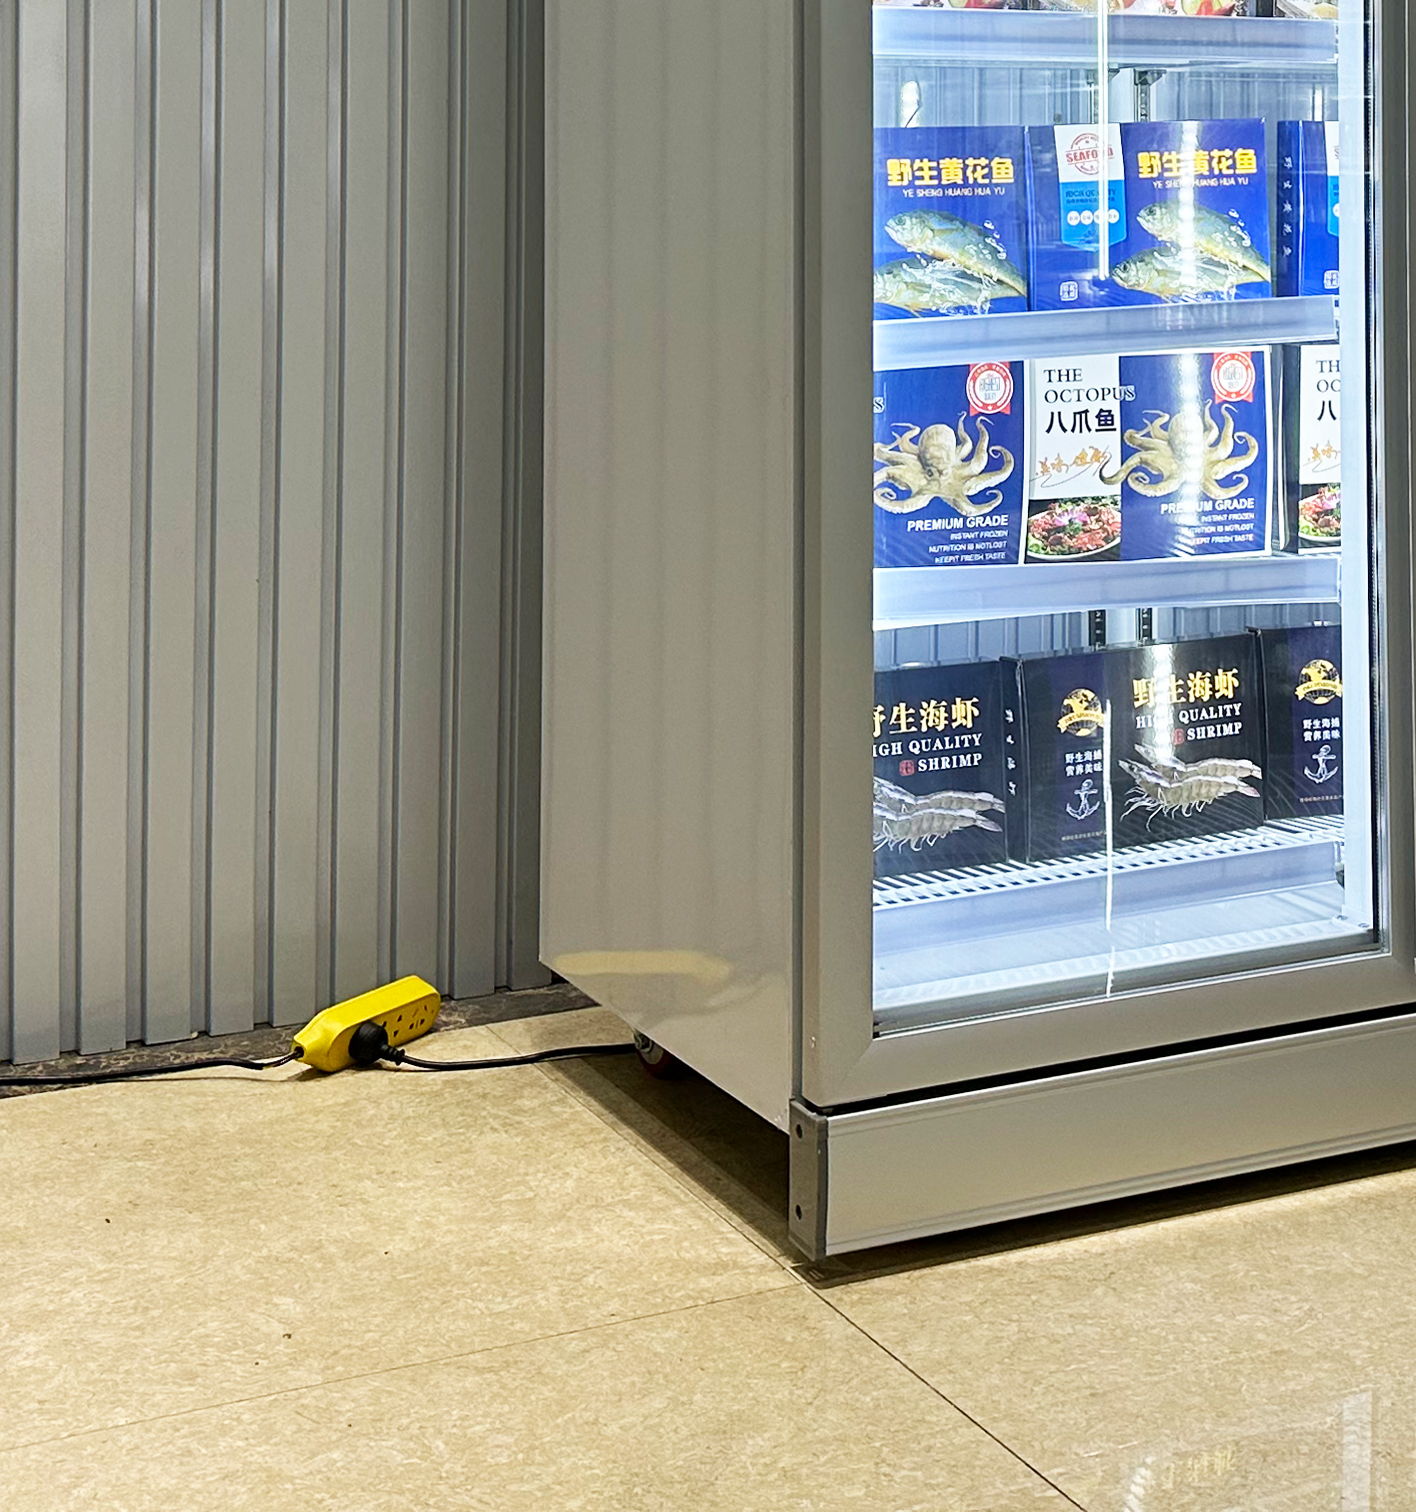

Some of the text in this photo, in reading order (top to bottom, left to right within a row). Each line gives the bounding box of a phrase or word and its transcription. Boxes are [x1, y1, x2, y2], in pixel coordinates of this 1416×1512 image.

[1066, 147, 1113, 162] SEAFOD
[886, 156, 1014, 186] 野生黄花鱼
[902, 187, 1005, 198] YE SHENG HUANG HUA YU
[1043, 368, 1083, 383] THE
[1044, 385, 1136, 404] OCTOPUS
[1045, 408, 1117, 433] 八爪鱼
[1161, 498, 1255, 514] PREUM GRADE
[907, 515, 1009, 532] PREMIUM GRADE
[1179, 703, 1242, 724] QUALITY
[1187, 722, 1242, 741] SHRIMP
[908, 733, 982, 755] QUALITY
[918, 753, 982, 772] SHRIMP
